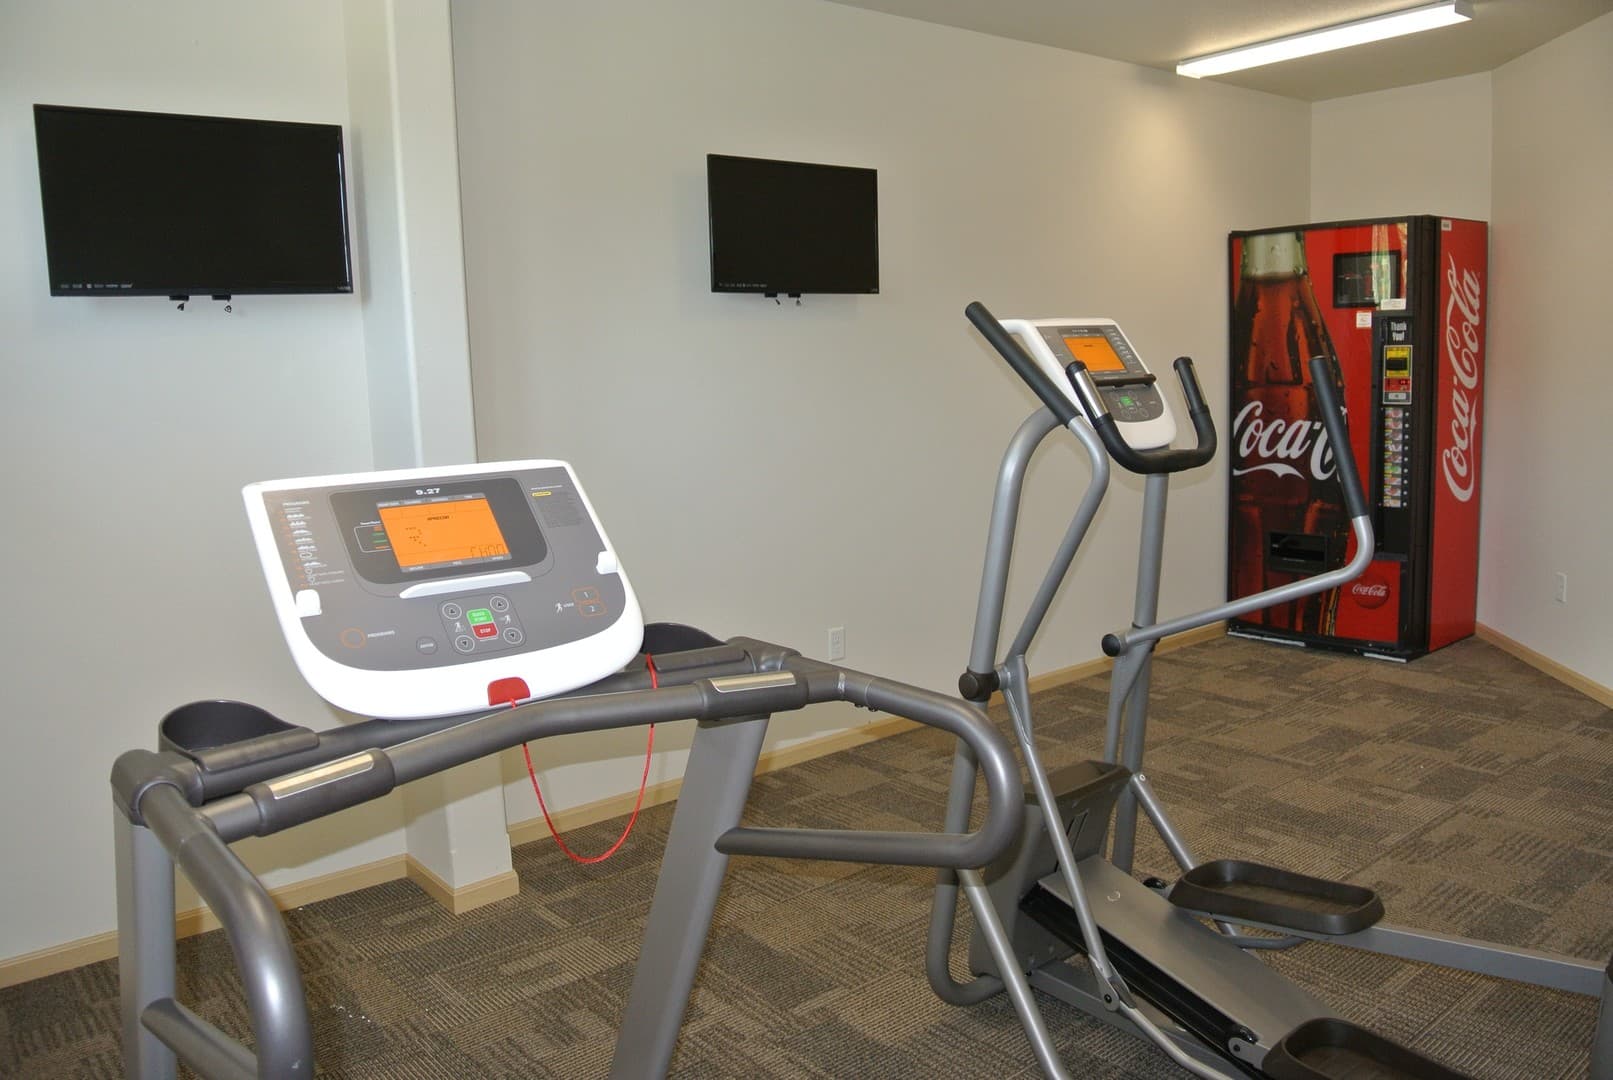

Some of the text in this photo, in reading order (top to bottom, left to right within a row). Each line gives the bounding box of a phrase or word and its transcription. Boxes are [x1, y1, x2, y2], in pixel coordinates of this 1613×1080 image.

[1442, 252, 1481, 502] Coca-Cola
[1232, 400, 1342, 482] Coca-C
[415, 487, 441, 496] 9.27
[1351, 583, 1388, 597] Coca-Cola
